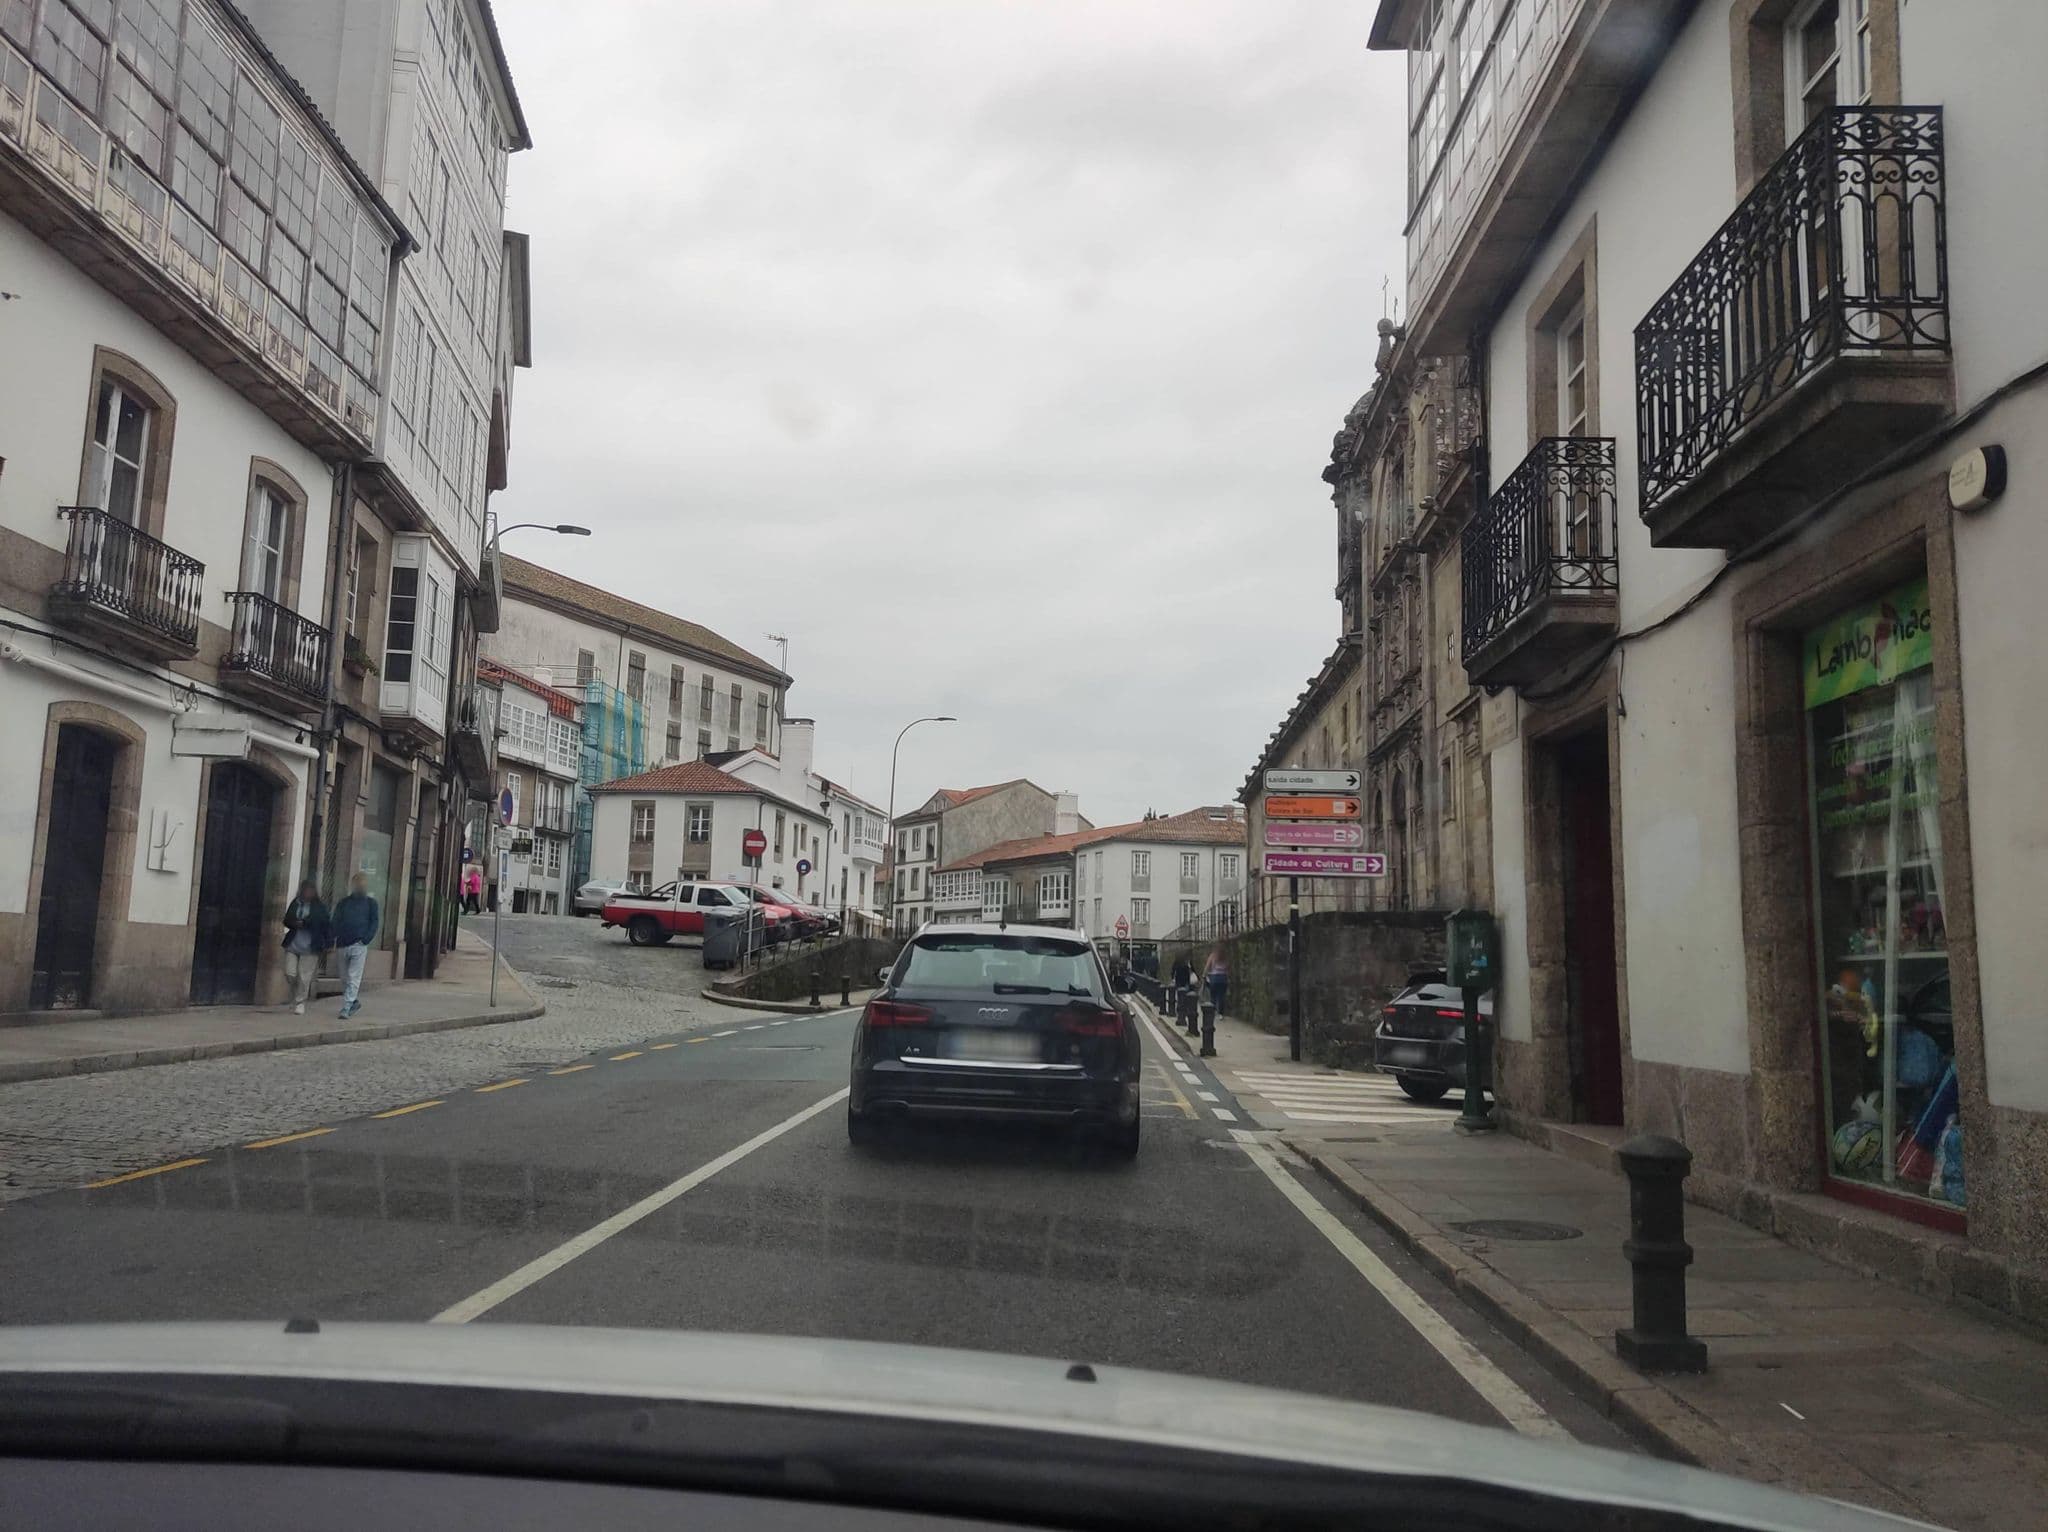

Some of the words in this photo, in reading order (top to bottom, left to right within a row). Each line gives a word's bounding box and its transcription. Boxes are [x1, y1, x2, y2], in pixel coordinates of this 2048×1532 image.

[1267, 858, 1298, 868] Cidade
[1301, 860, 1312, 868] da
[1315, 860, 1349, 869] Cultura
